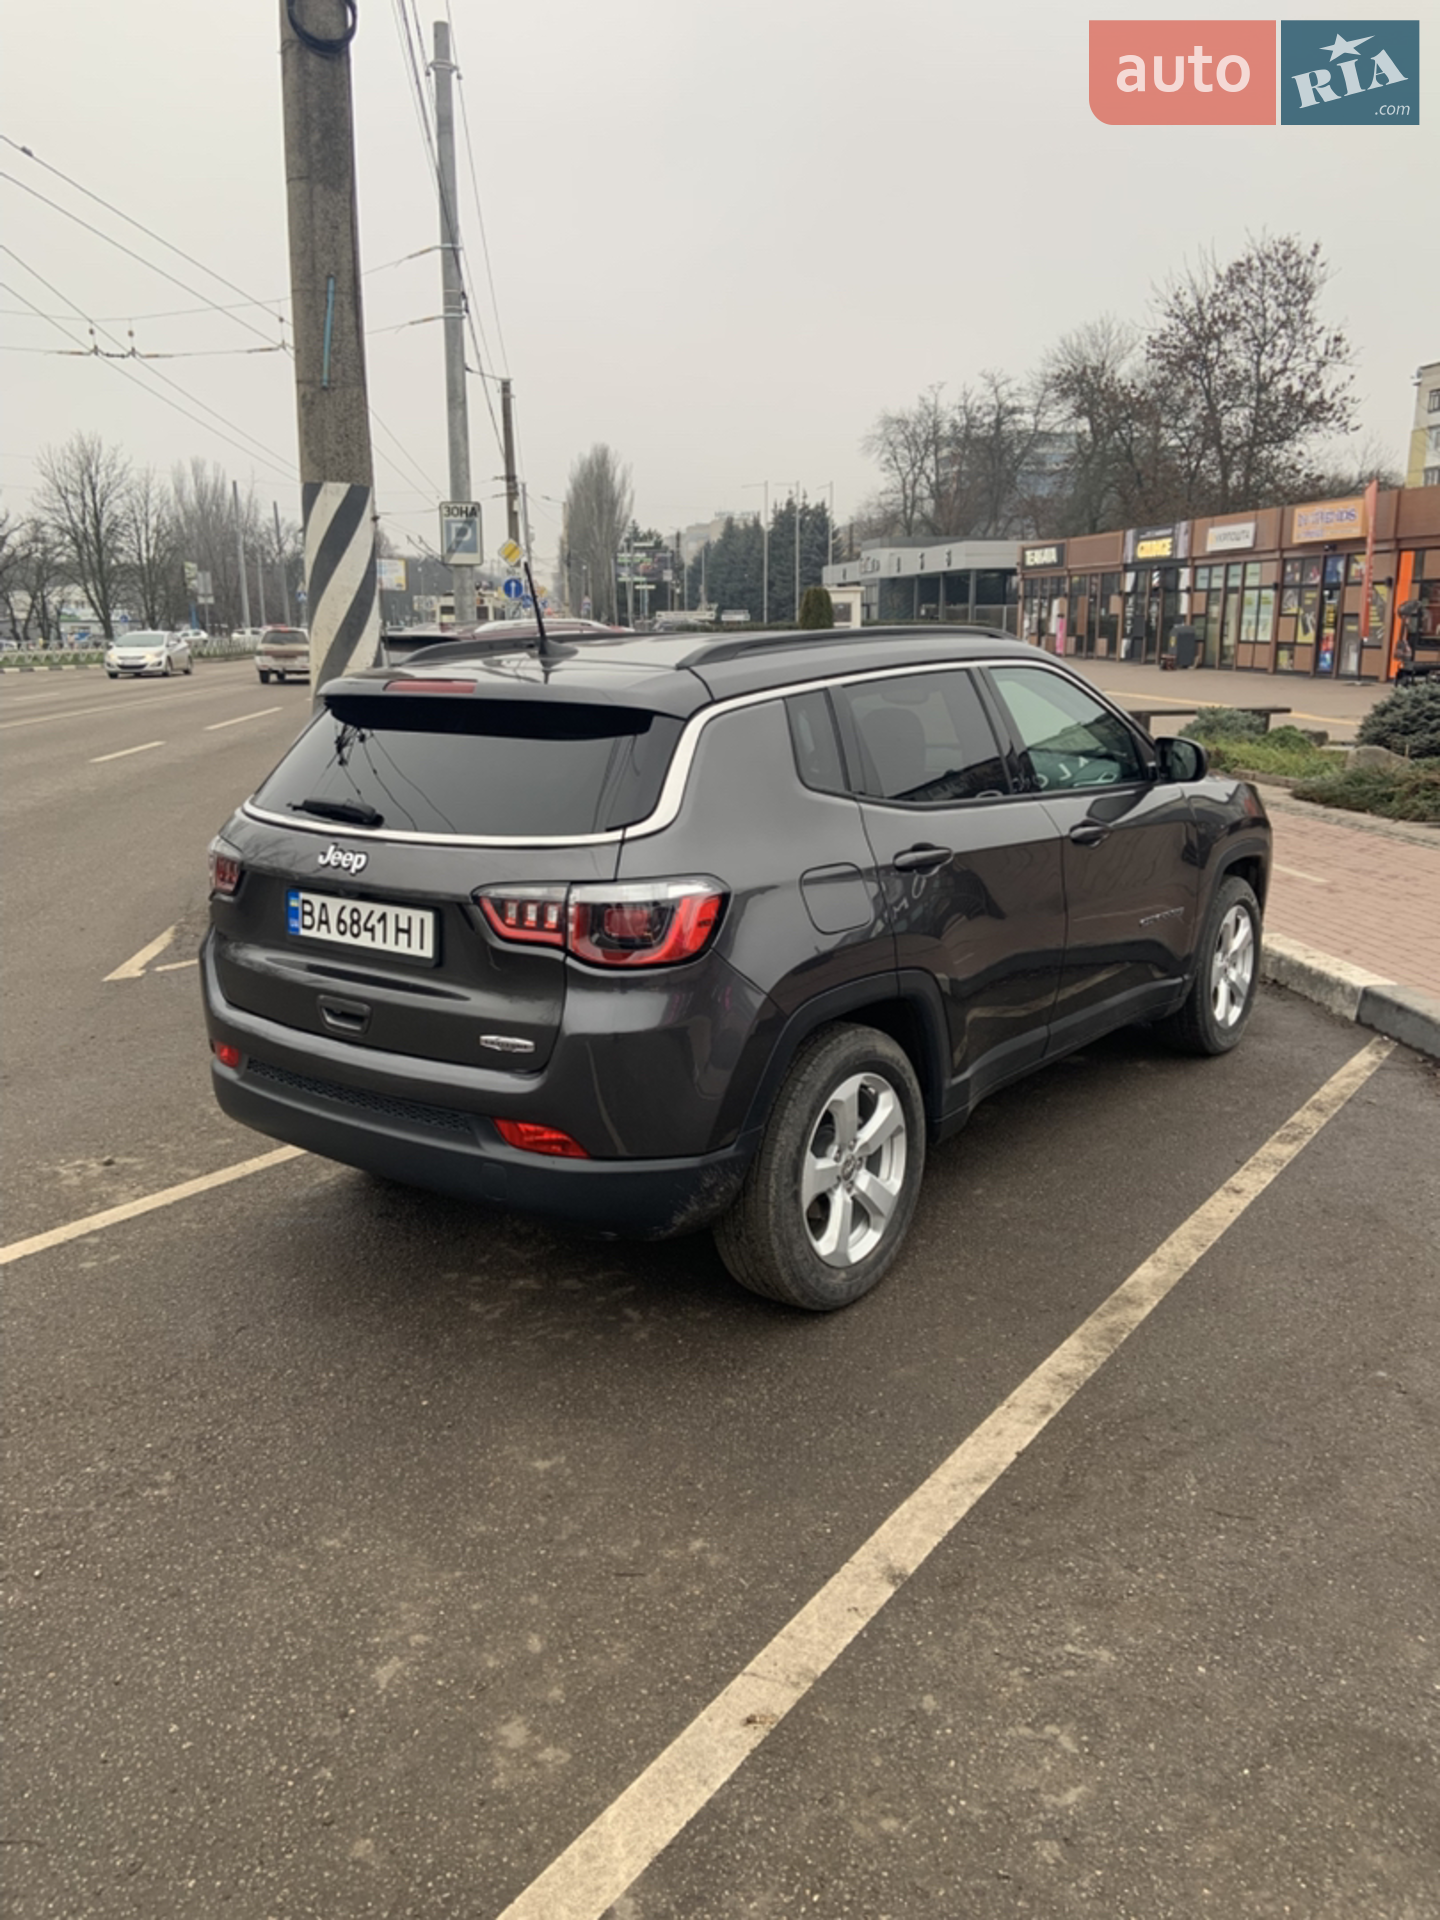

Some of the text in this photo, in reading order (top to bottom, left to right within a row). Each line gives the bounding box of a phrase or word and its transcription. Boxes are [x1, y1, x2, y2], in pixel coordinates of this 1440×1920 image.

[443, 505, 478, 518] ЗОНА
[317, 845, 367, 874] Jeep
[301, 899, 331, 934] BA
[336, 905, 387, 944] 6841
